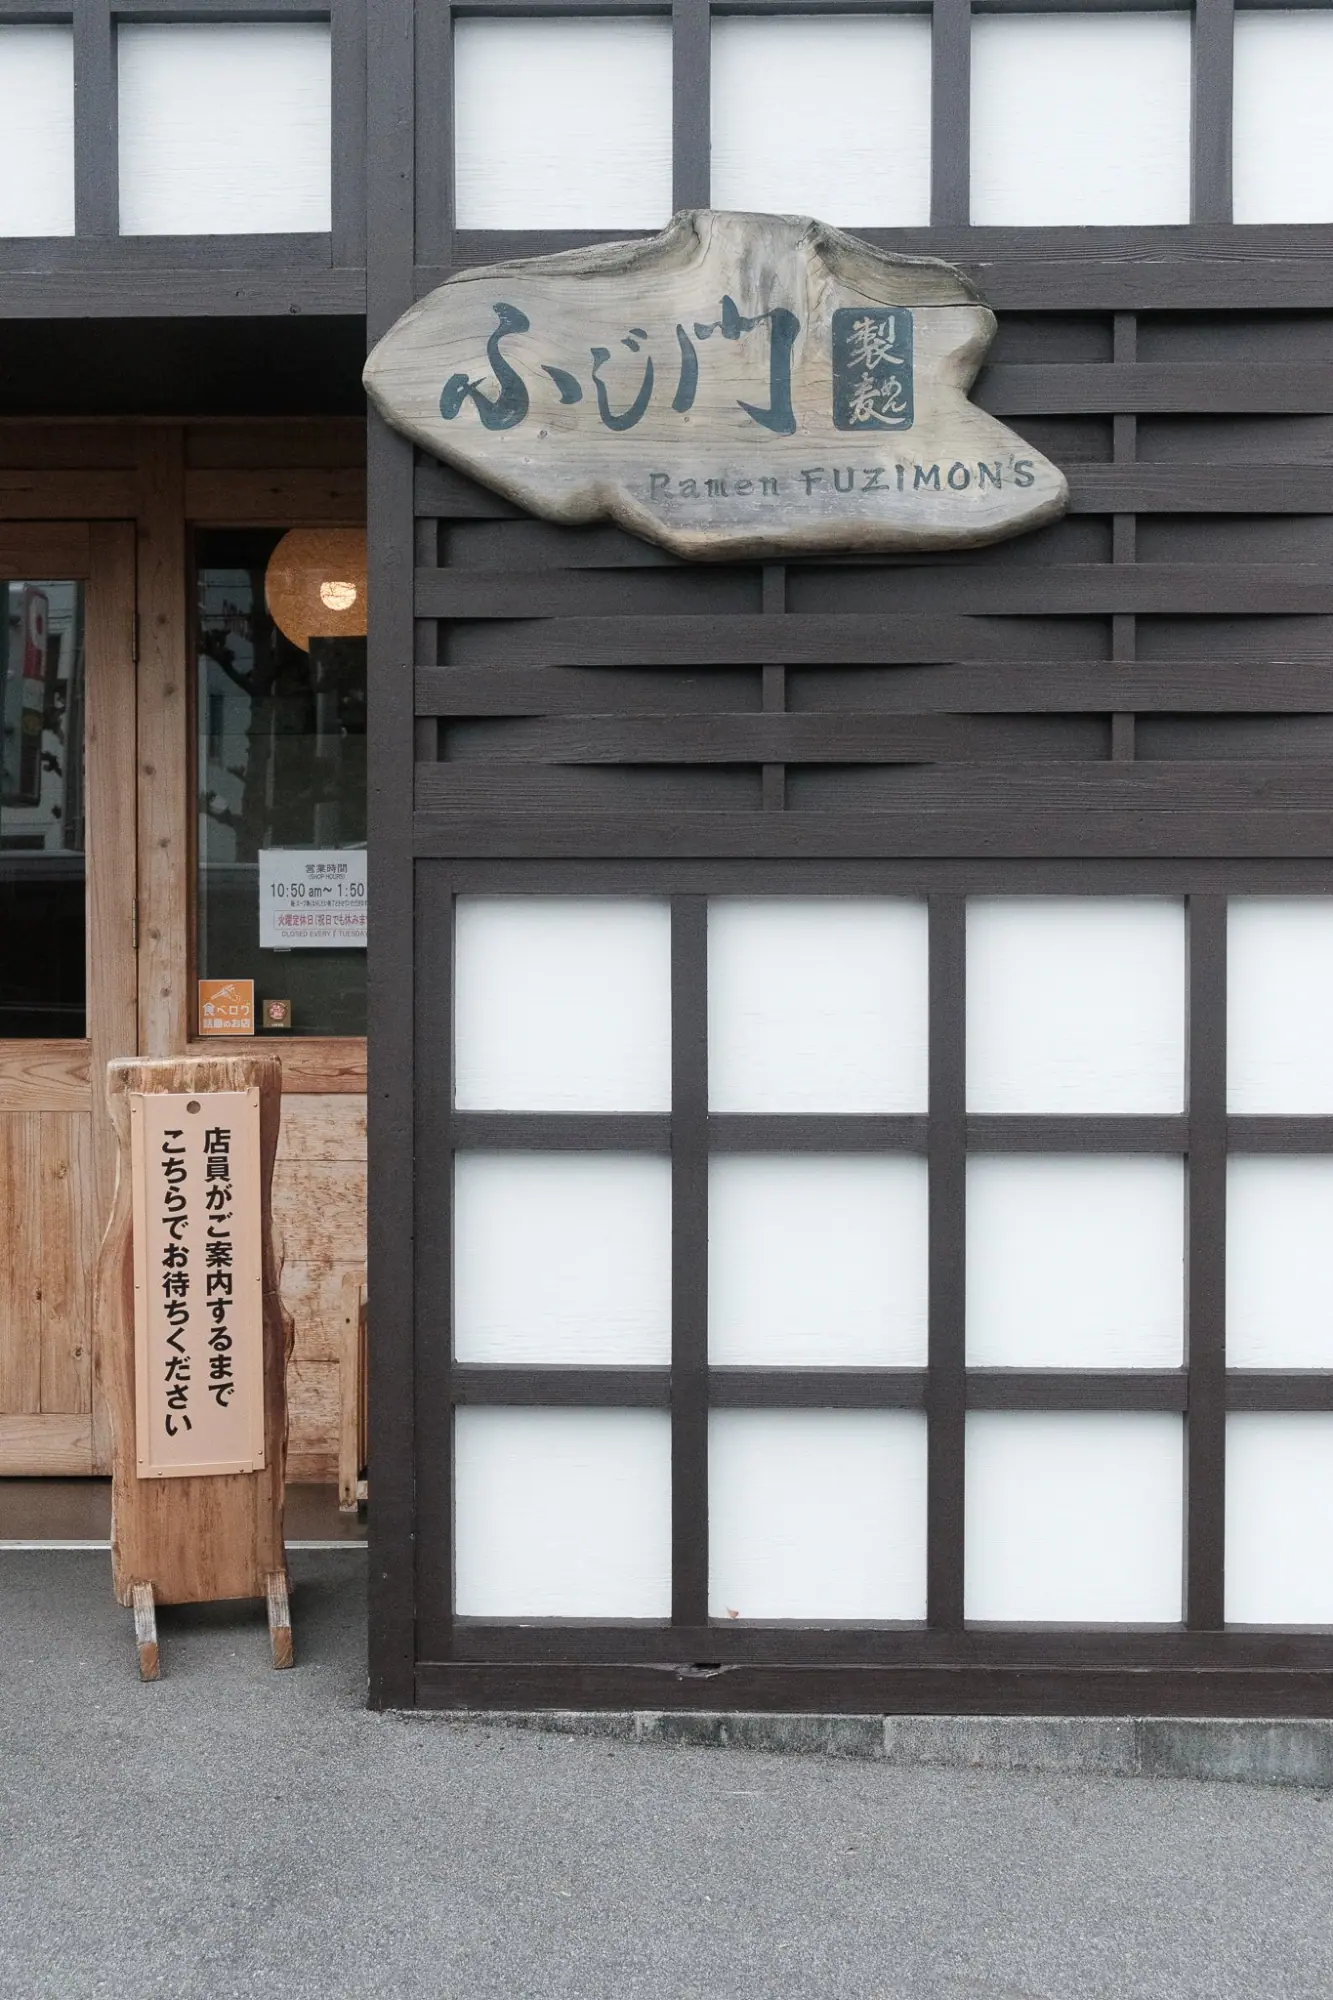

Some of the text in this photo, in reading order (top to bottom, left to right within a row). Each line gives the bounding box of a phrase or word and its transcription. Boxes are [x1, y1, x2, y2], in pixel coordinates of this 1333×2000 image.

[439, 295, 800, 436] ふじ門
[649, 454, 1036, 499] Ramen FUZIMON'S
[271, 883, 305, 898] 10:50
[337, 883, 364, 898] 1:50
[305, 864, 348, 874] 営業時間
[161, 1129, 192, 1438] こちらでお待ちください
[203, 1126, 234, 1409] 店員がご案内するまで
